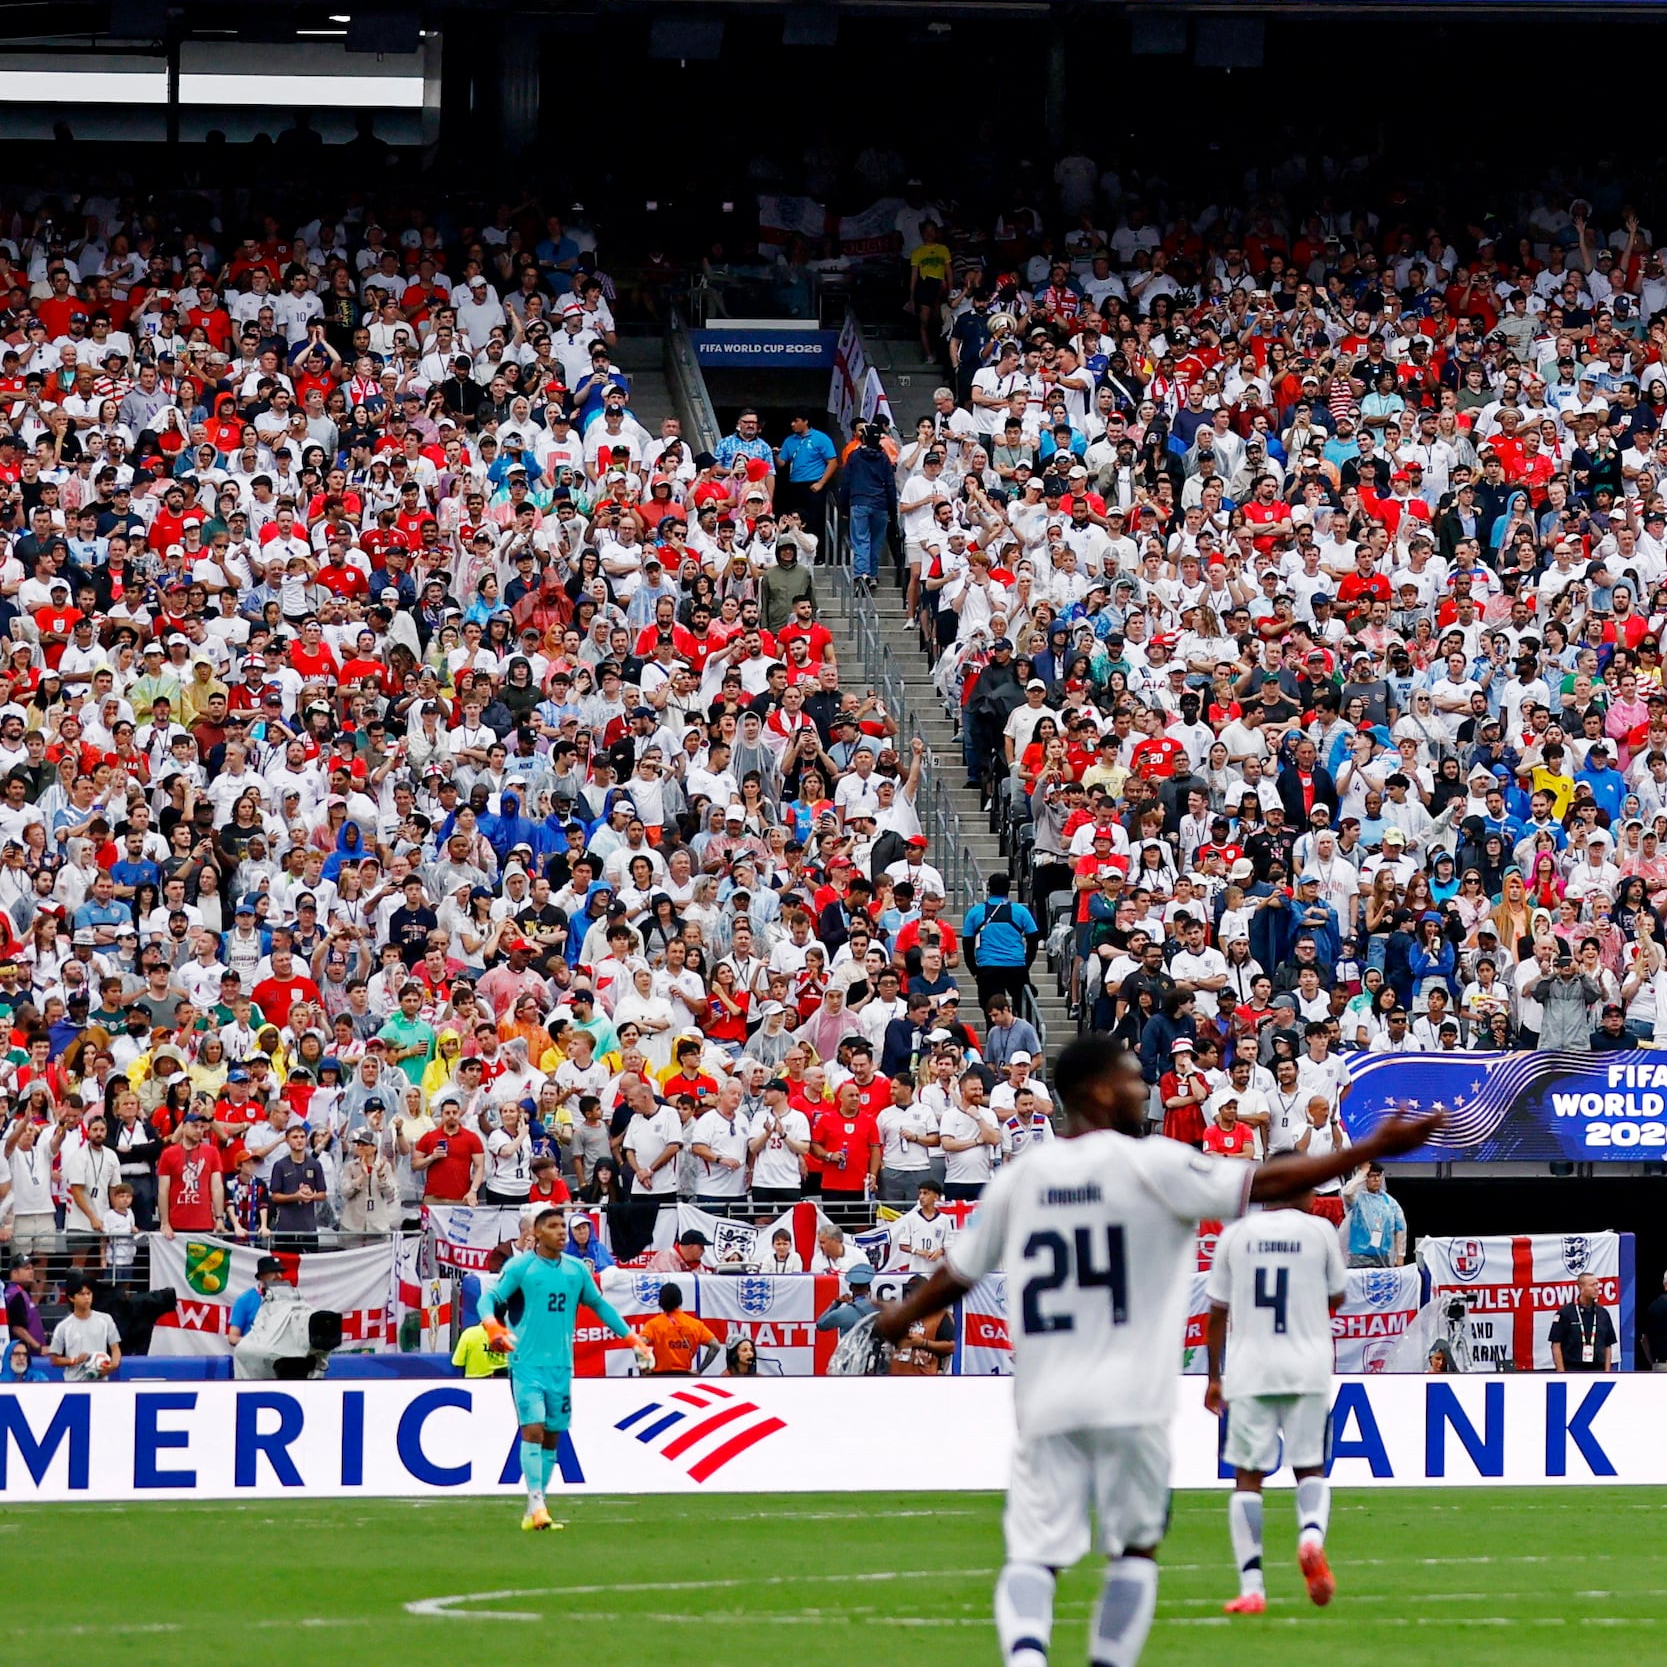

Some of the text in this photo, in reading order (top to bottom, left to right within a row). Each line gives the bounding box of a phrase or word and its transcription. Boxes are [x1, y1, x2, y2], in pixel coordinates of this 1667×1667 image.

[700, 343, 822, 354] FIFA WORLD CUP 2026
[1150, 752, 1164, 764] 20
[194, 983, 201, 994] 4
[1551, 1093, 1664, 1117] WORLD
[771, 1138, 783, 1149] 25
[921, 1237, 932, 1250] 10
[453, 1247, 489, 1268] CITY
[1023, 1223, 1128, 1337] 24
[548, 1293, 566, 1312] 22
[1254, 1266, 1289, 1334] 4
[1218, 1381, 1619, 1478] ANK
